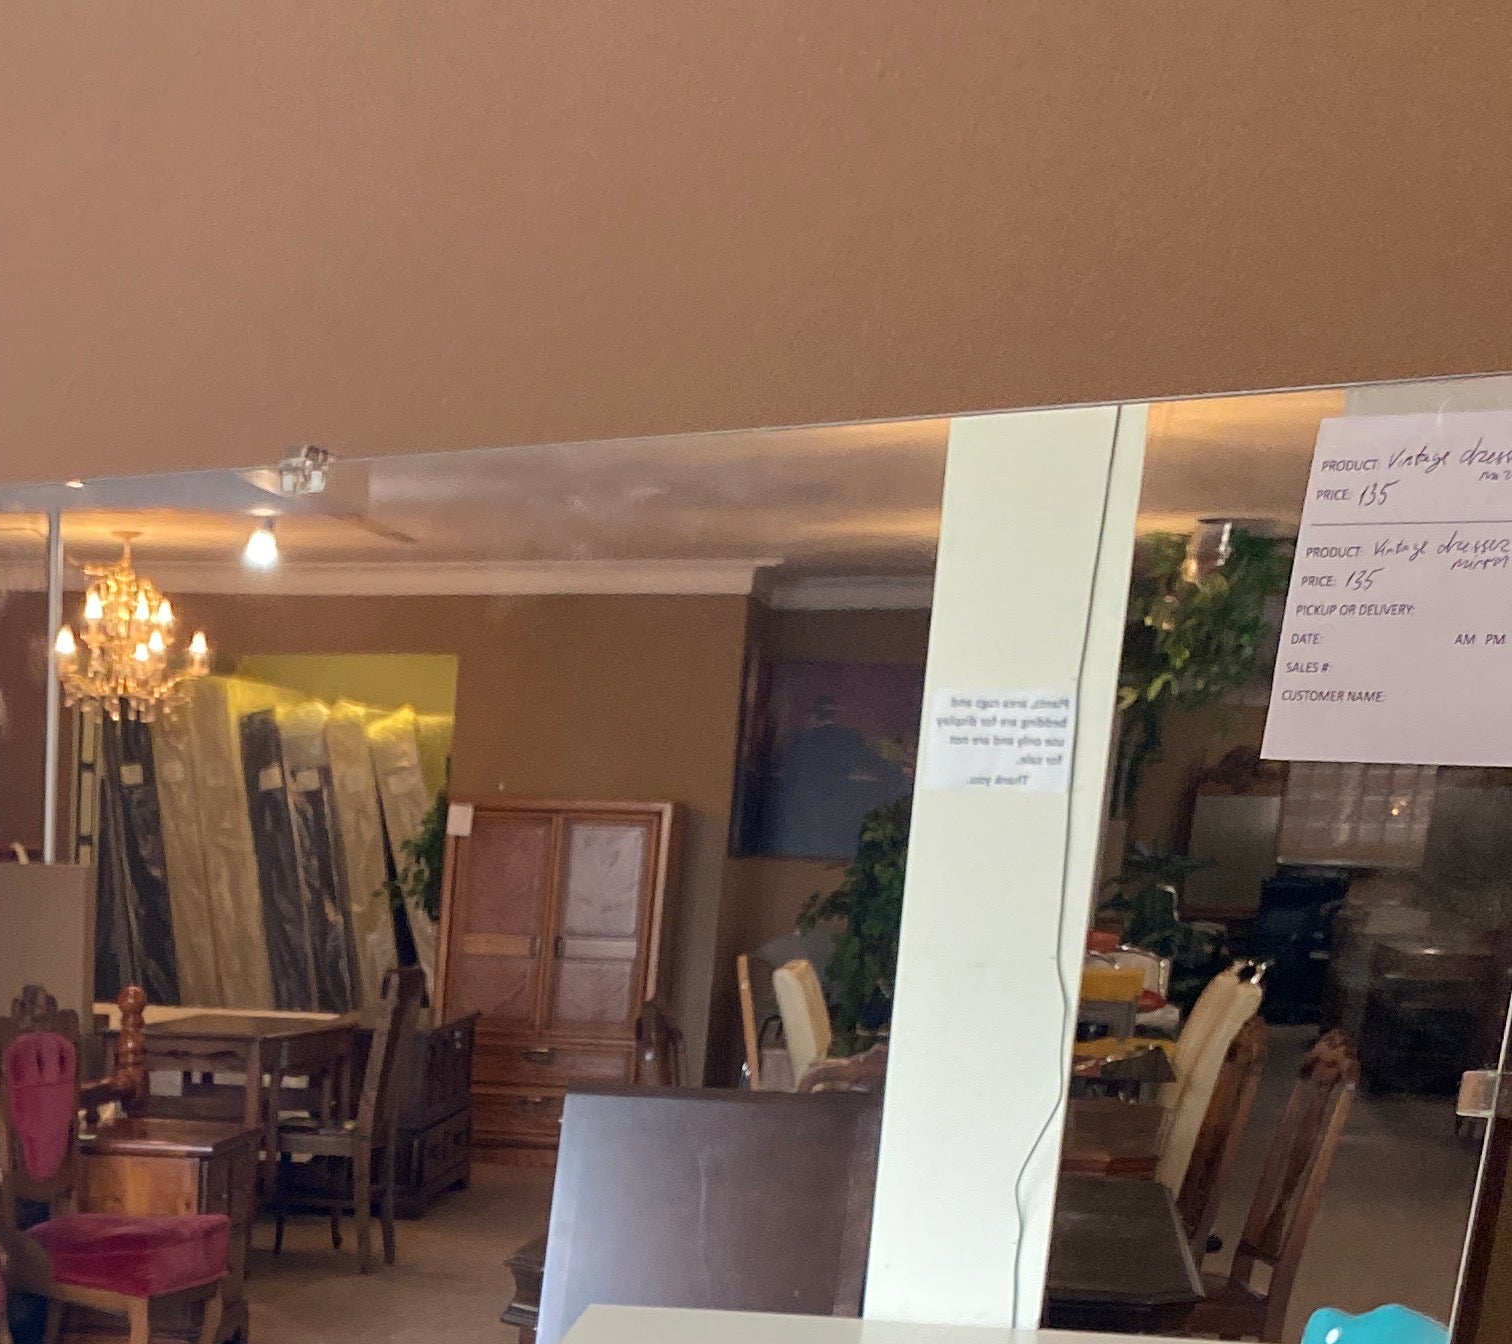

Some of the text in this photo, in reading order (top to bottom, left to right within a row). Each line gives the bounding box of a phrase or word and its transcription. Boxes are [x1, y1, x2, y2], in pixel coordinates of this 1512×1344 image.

[1357, 480, 1400, 507] 135
[1345, 567, 1385, 591] 135
[1295, 604, 1416, 616] PICKUP OR DELIVERY:
[1454, 634, 1476, 646] AM
[1484, 634, 1506, 646] PM
[1286, 662, 1319, 673] SALES
[1281, 690, 1345, 702] CUSTOMER
